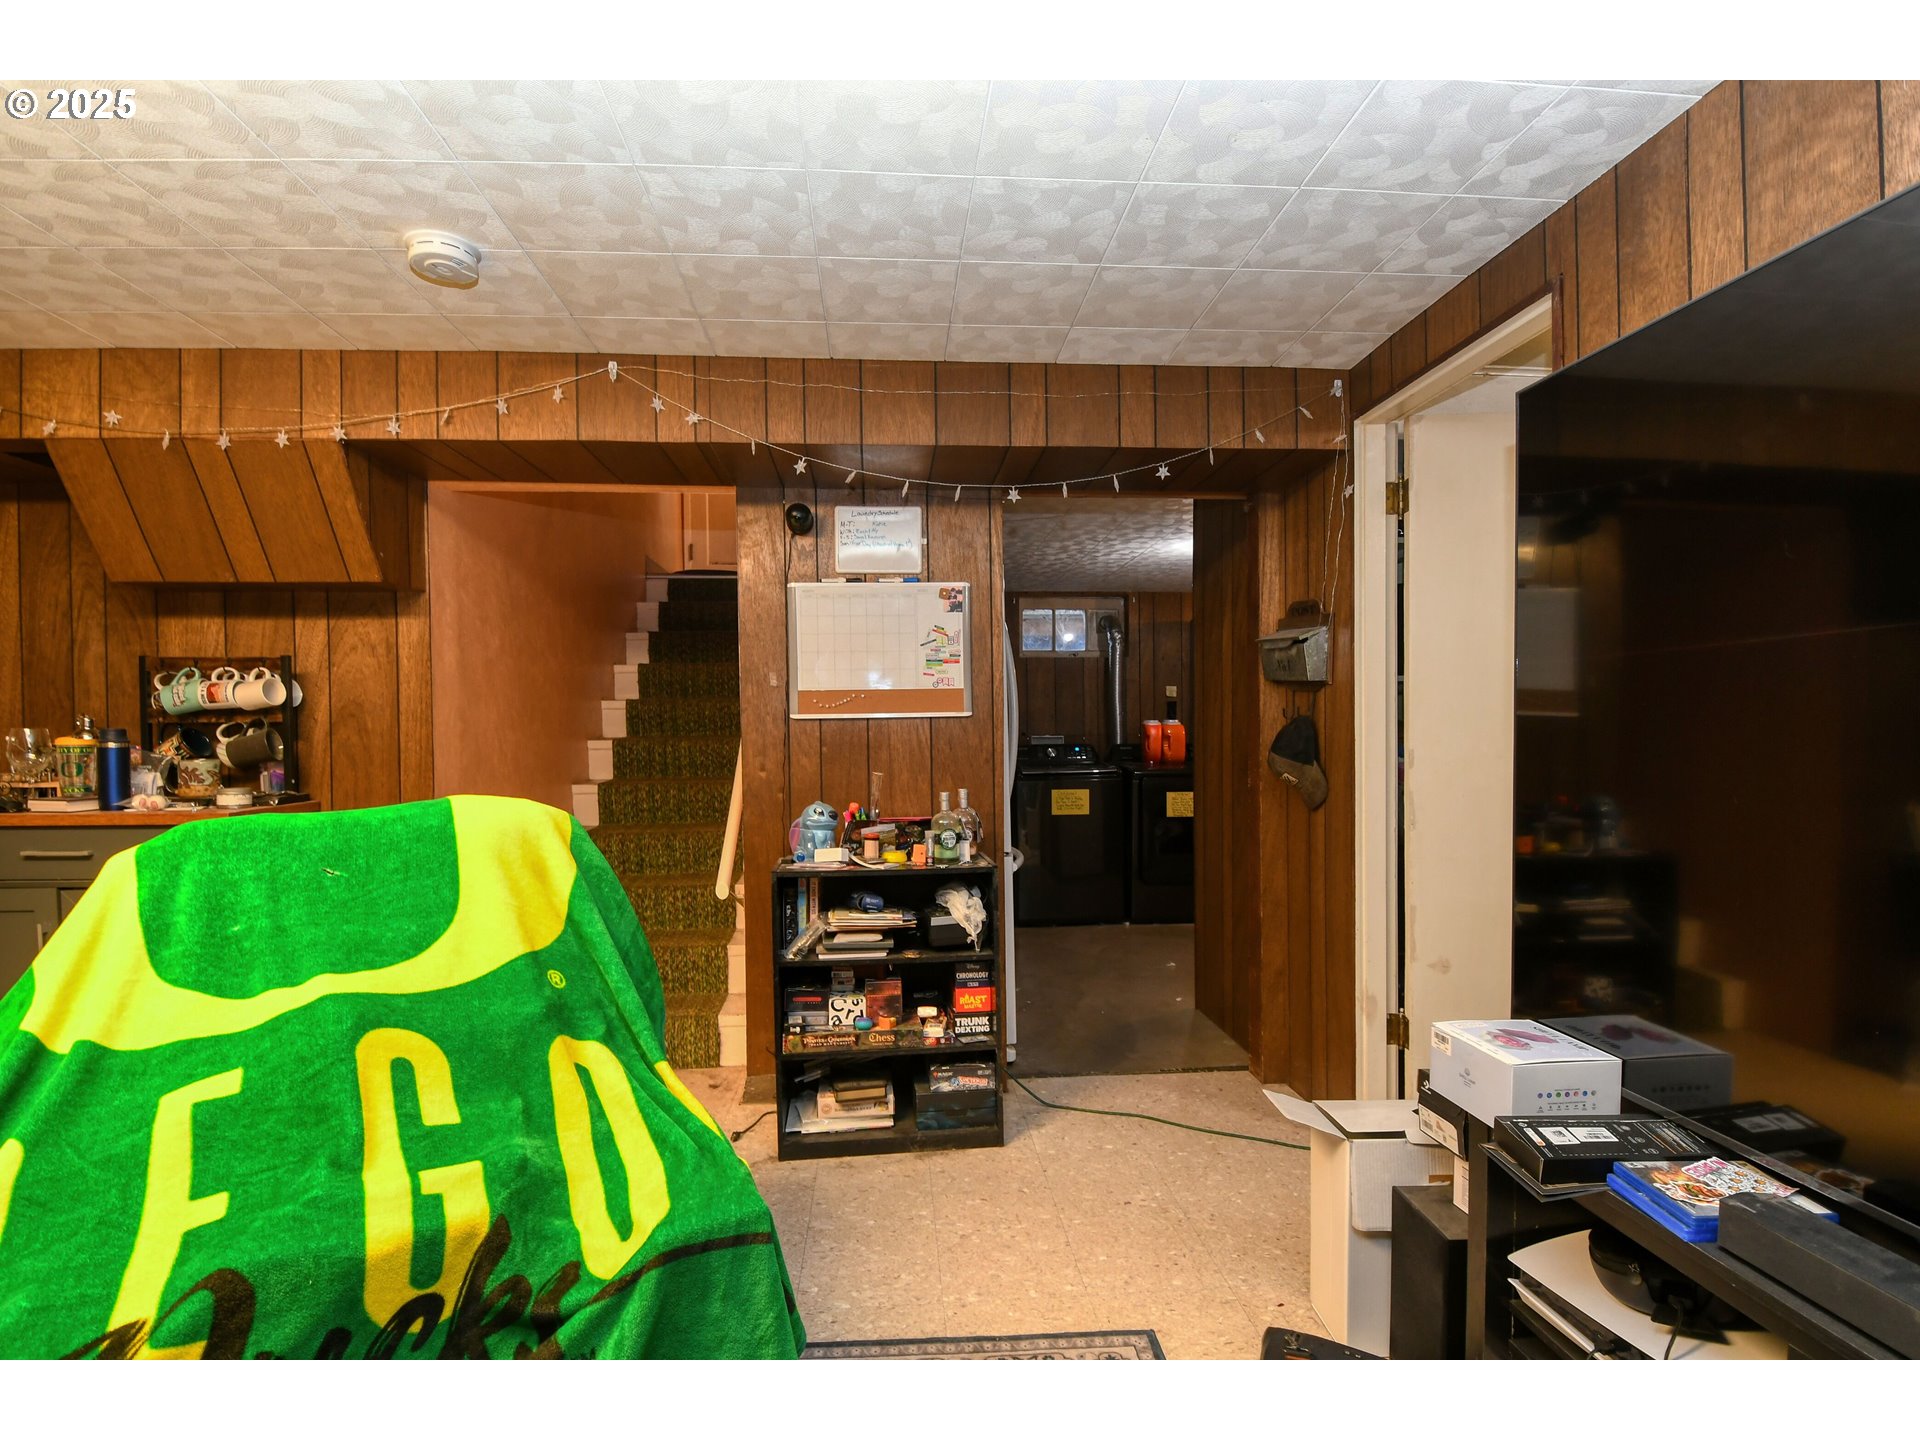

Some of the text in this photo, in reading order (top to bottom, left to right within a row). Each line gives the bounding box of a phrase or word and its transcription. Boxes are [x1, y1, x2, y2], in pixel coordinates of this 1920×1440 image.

[956, 971, 989, 979] CHRONOLOGY
[960, 993, 988, 1005] ROAST
[955, 1016, 990, 1027] TRUNK
[955, 1025, 990, 1034] DEXTING
[868, 1032, 896, 1042] Chess
[0, 1027, 749, 1359] EGO
